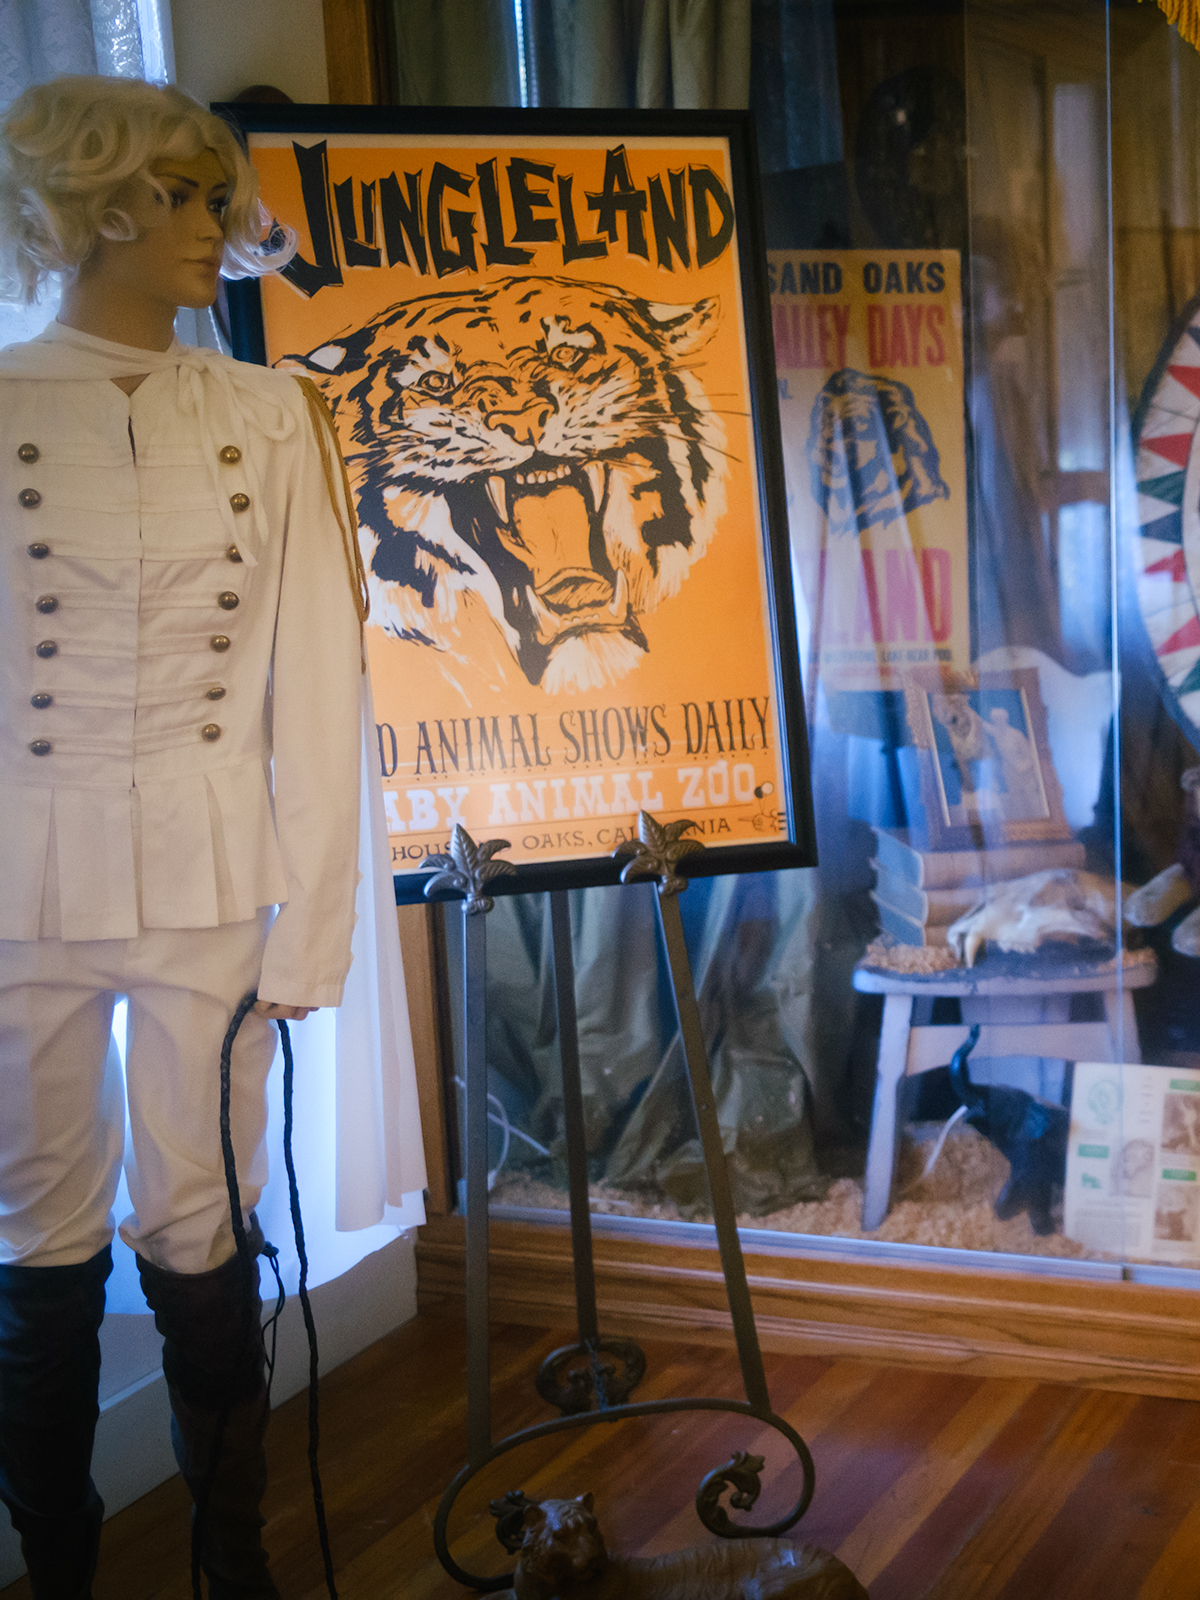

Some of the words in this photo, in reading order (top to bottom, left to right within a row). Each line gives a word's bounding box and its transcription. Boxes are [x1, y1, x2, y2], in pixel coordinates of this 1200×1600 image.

[280, 140, 736, 299] JUNGLELAND
[863, 262, 946, 294] OAKS
[866, 304, 946, 369] DAYS
[414, 713, 552, 776] ANIMAL
[559, 703, 672, 765] SHOWS
[681, 696, 769, 756] DAILY
[488, 770, 664, 825] ANIMAL
[677, 762, 756, 809] ZOO
